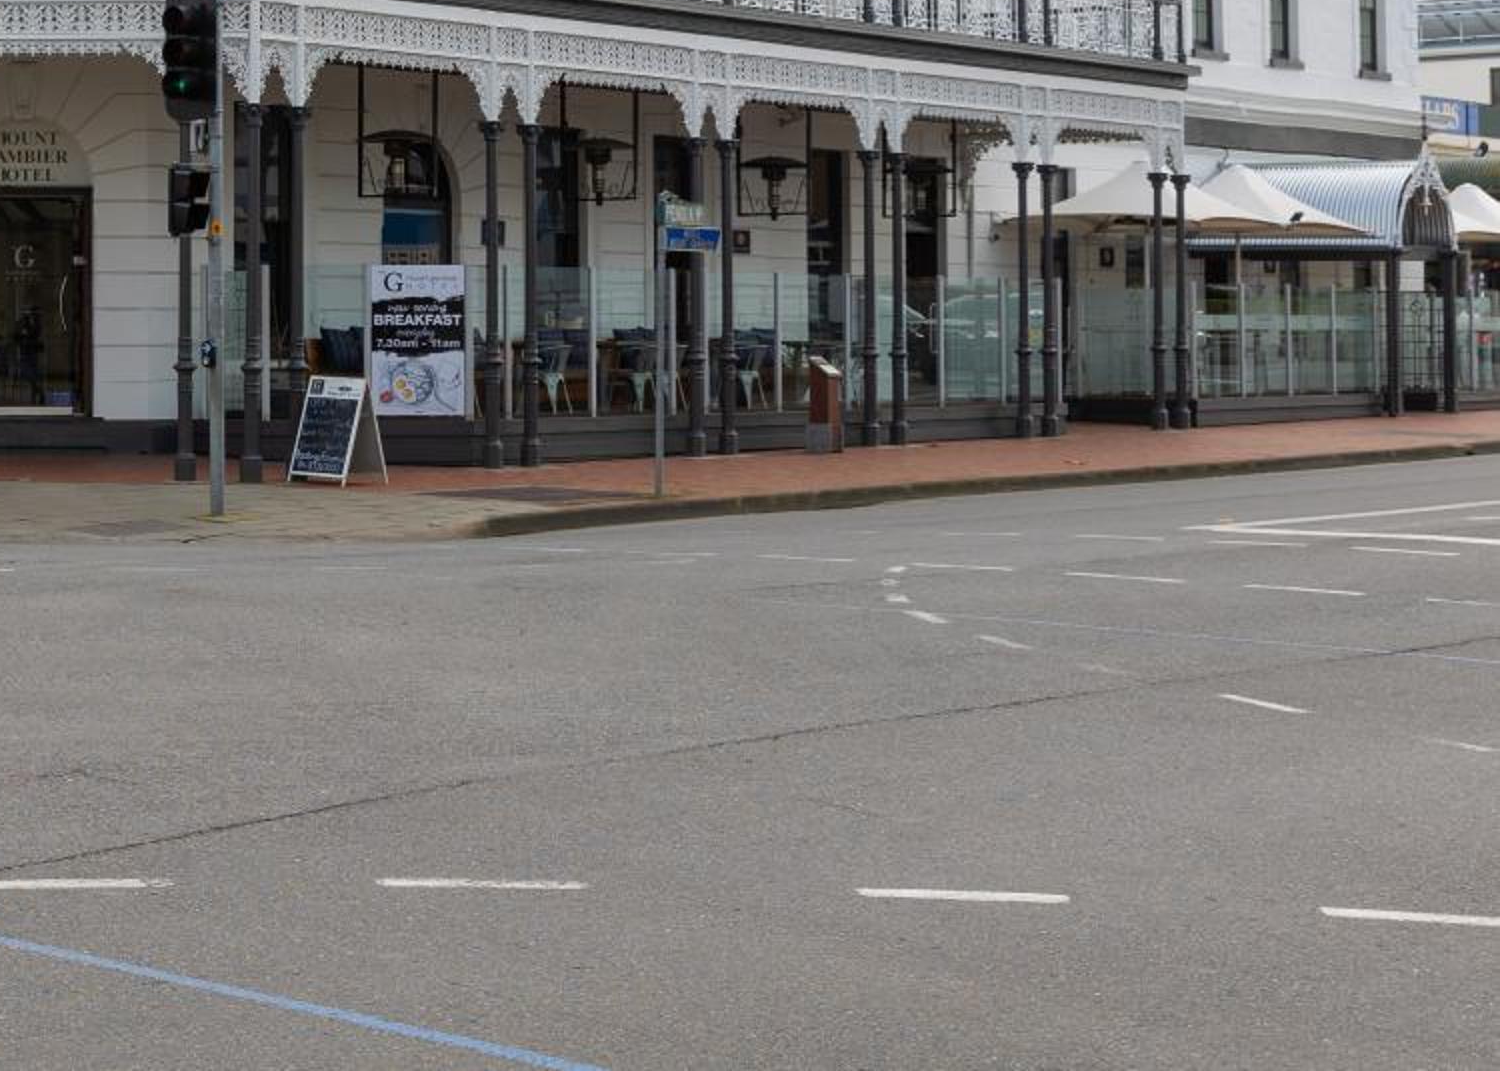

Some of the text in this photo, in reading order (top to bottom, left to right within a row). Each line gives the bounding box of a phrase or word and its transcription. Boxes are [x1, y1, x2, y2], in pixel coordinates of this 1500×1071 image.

[13, 244, 36, 269] G
[384, 272, 404, 292] G
[373, 314, 462, 326] BREAKFAST
